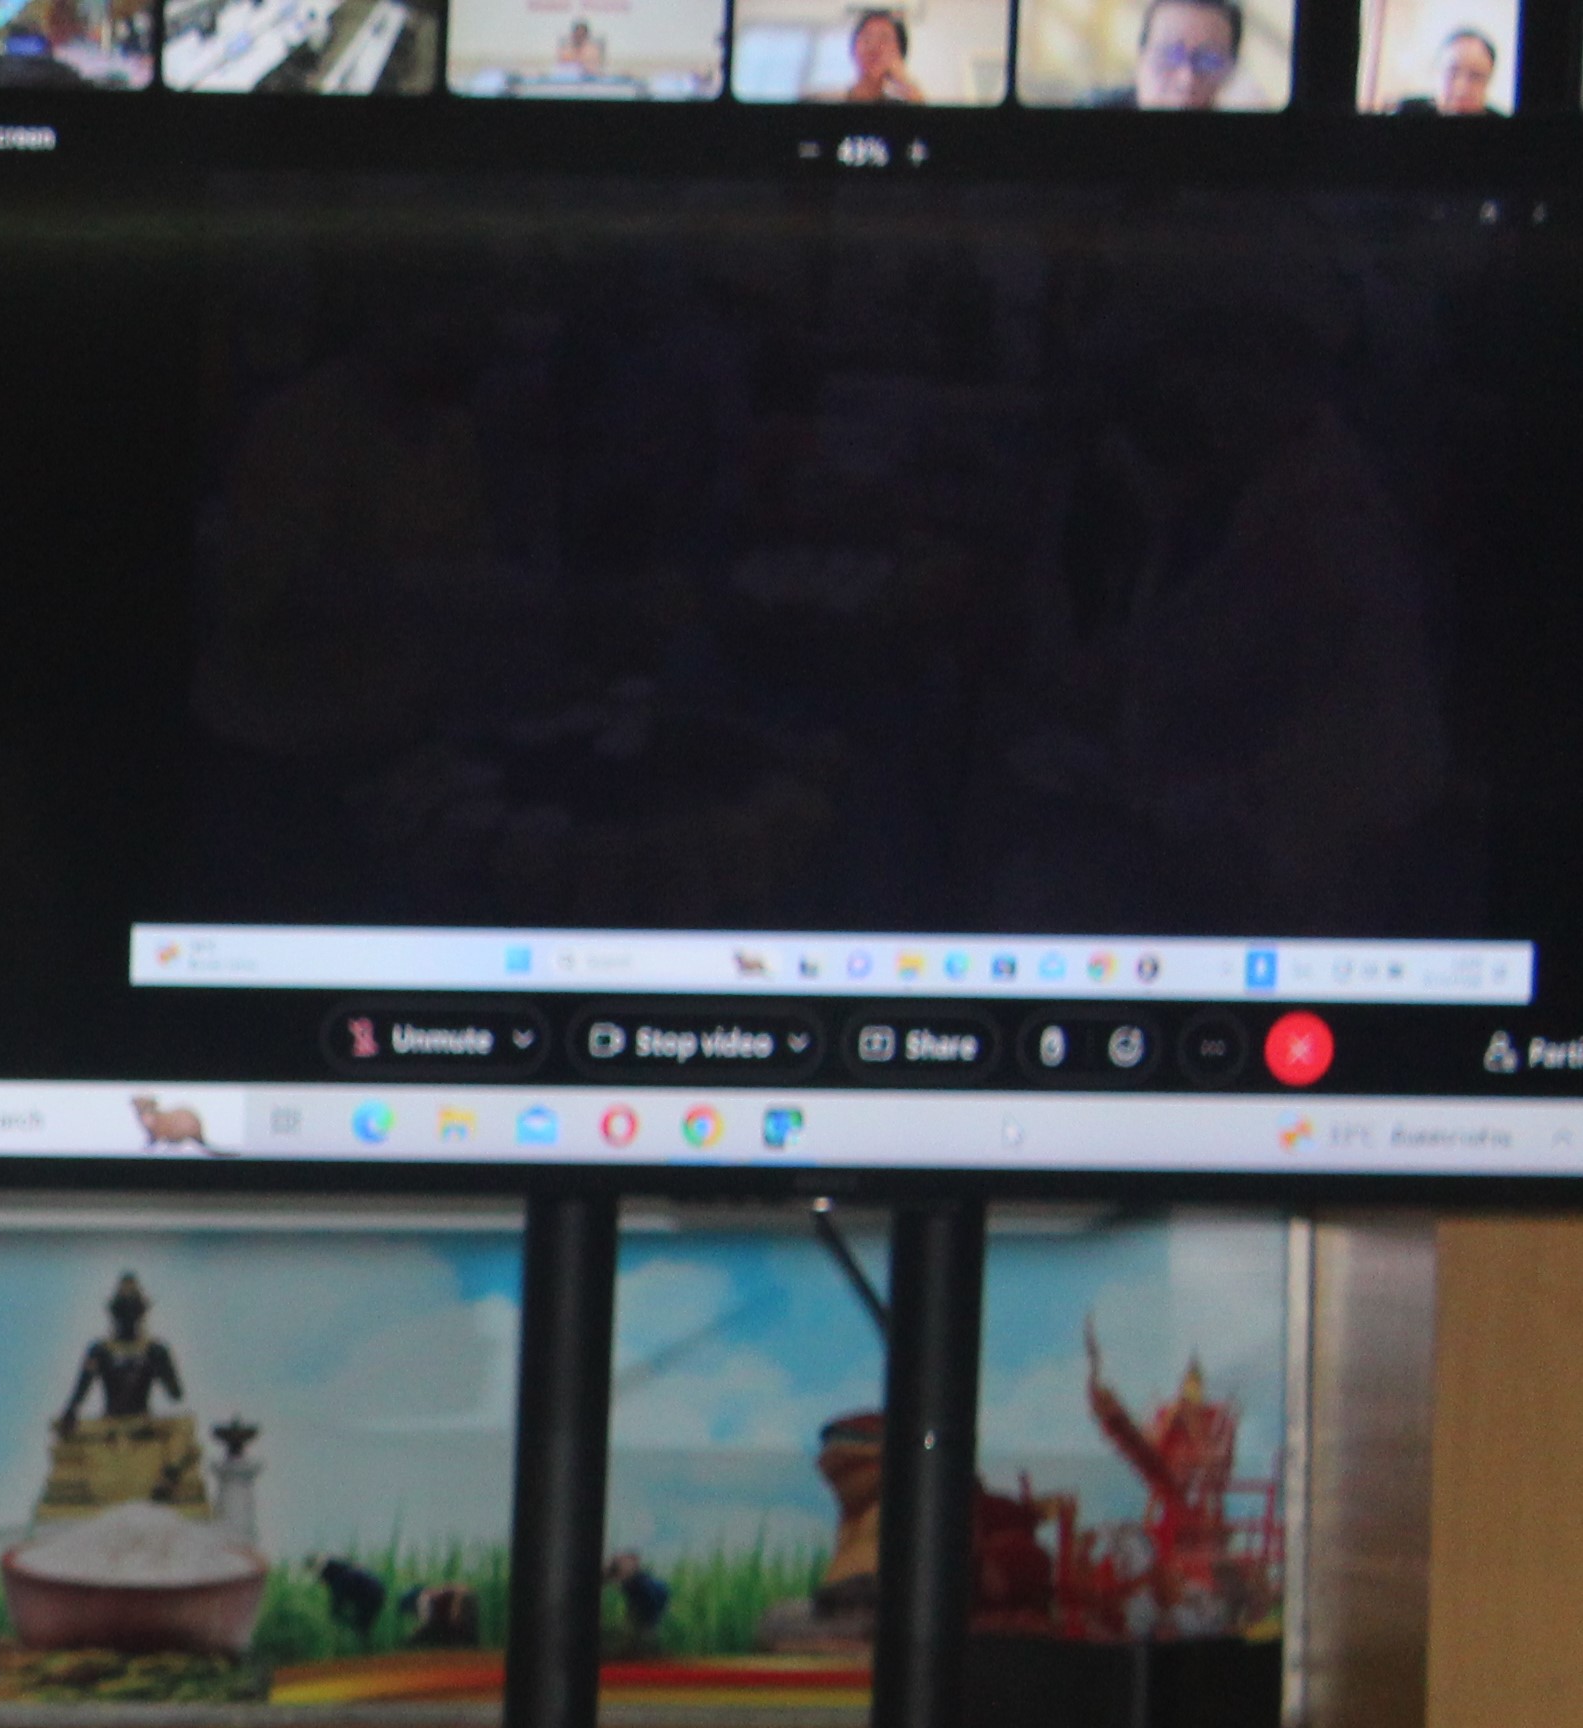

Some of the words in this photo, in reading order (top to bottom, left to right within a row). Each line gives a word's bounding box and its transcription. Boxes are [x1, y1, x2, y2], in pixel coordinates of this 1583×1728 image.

[392, 1022, 494, 1056] Unmute
[635, 1025, 698, 1064] Stop
[700, 1024, 774, 1060] video
[906, 1027, 979, 1062] Share
